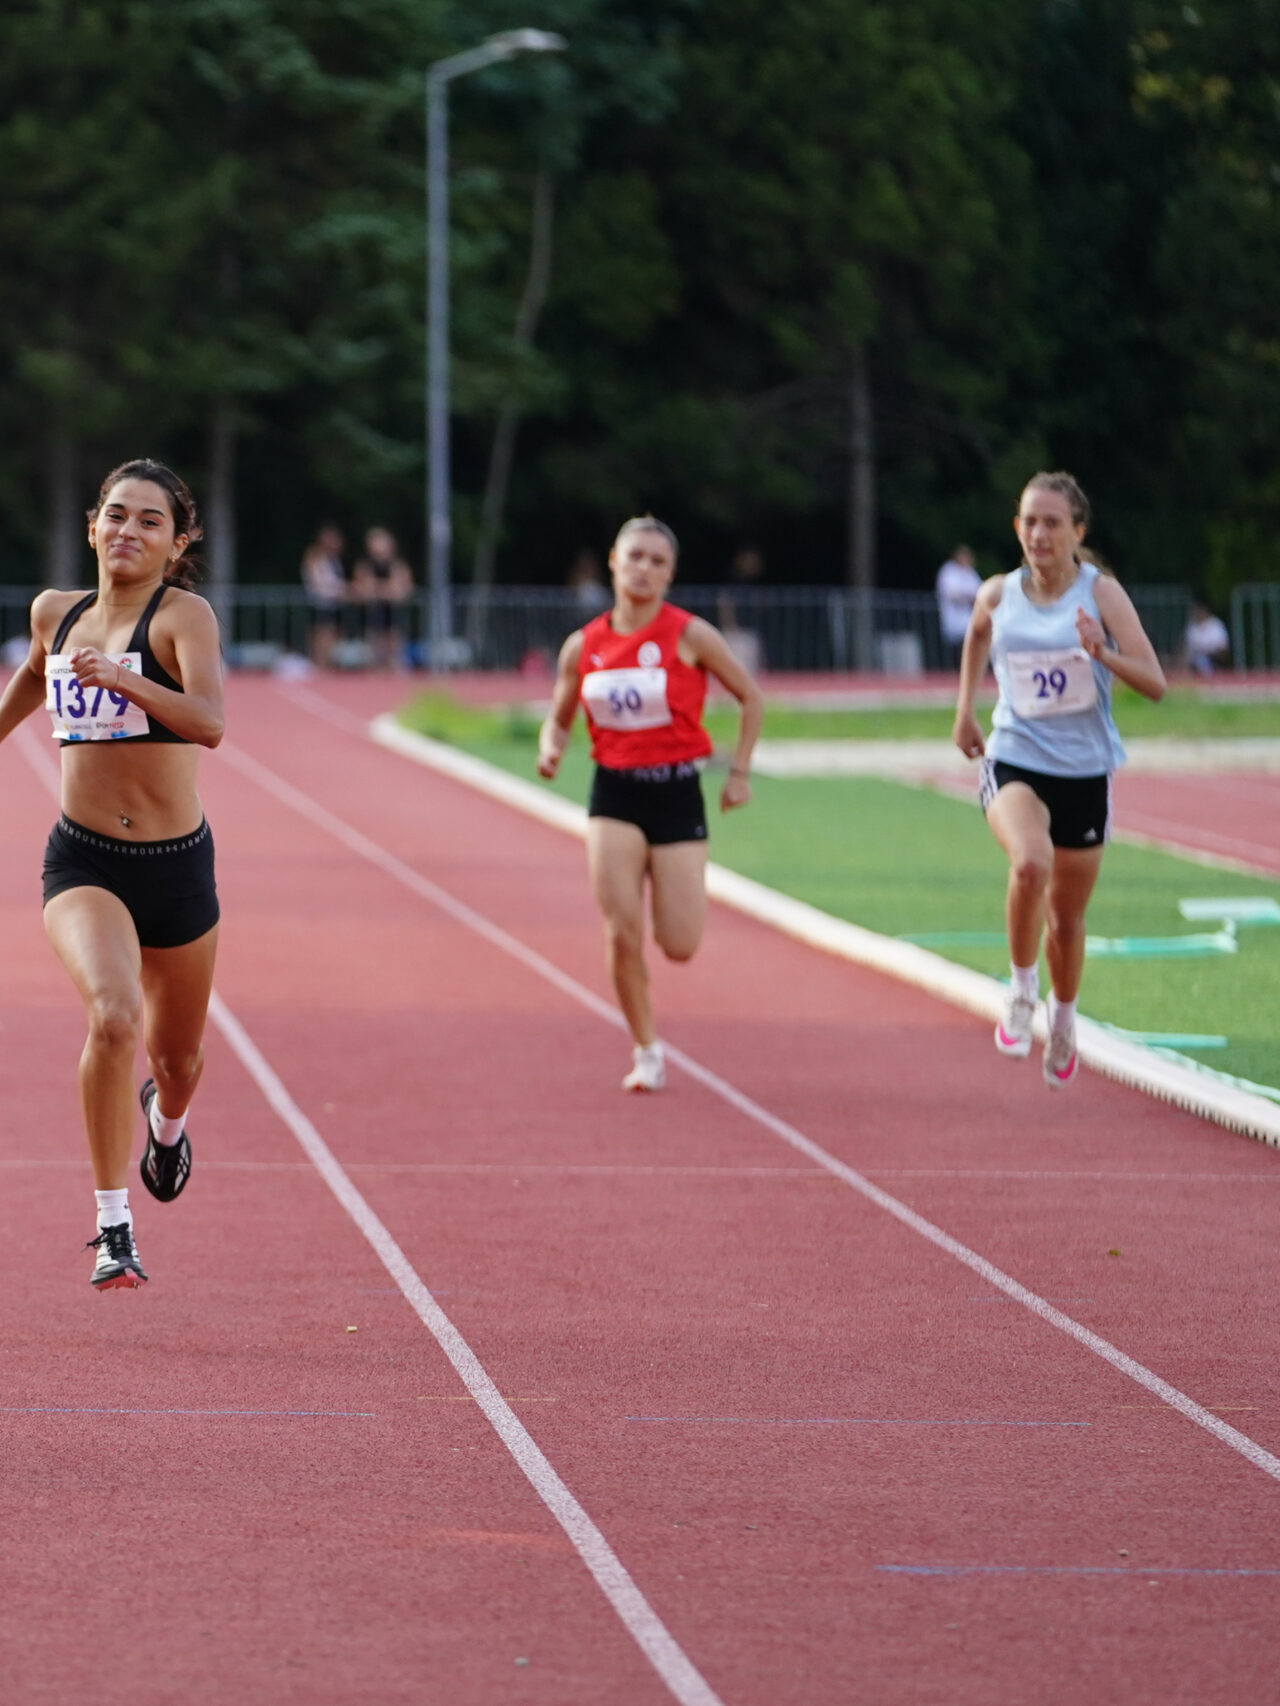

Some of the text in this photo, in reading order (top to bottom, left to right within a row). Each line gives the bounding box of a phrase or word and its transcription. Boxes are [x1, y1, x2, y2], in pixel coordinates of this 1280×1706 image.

[1032, 668, 1067, 698] 29
[52, 678, 130, 719] 1379
[608, 687, 642, 716] 50
[113, 846, 163, 856] ARMOUR
